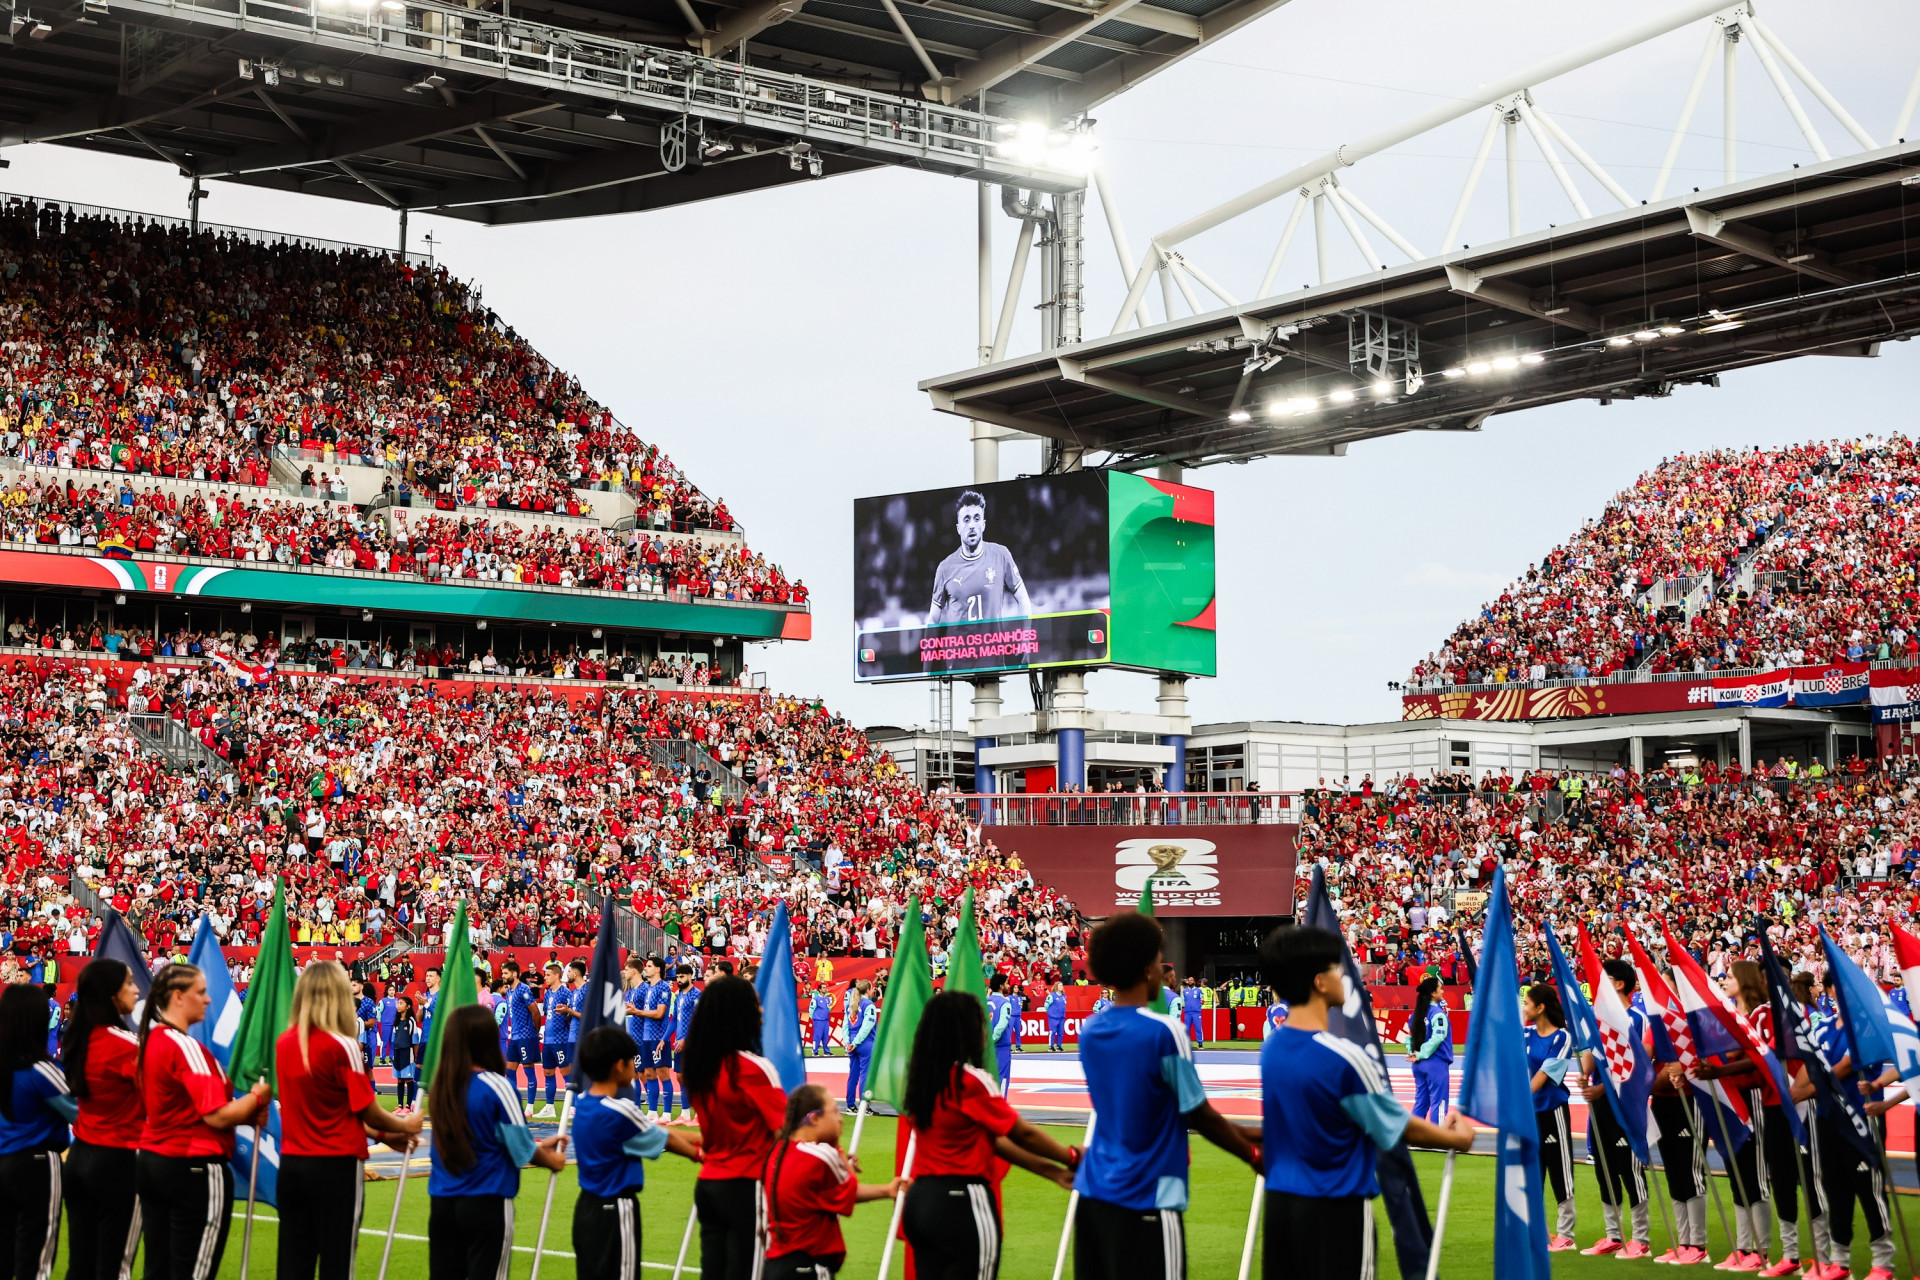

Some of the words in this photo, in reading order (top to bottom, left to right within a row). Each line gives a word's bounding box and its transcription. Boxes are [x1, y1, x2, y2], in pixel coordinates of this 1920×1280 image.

[967, 594, 984, 621] 21
[920, 635, 964, 650] CONTRA
[966, 633, 983, 646] OS
[983, 628, 1038, 645] CANHÕES
[920, 646, 978, 662] MARCHAR,
[1802, 680, 1825, 693] LUD
[1842, 672, 1869, 689] BREG
[1720, 690, 1742, 700] KOMU
